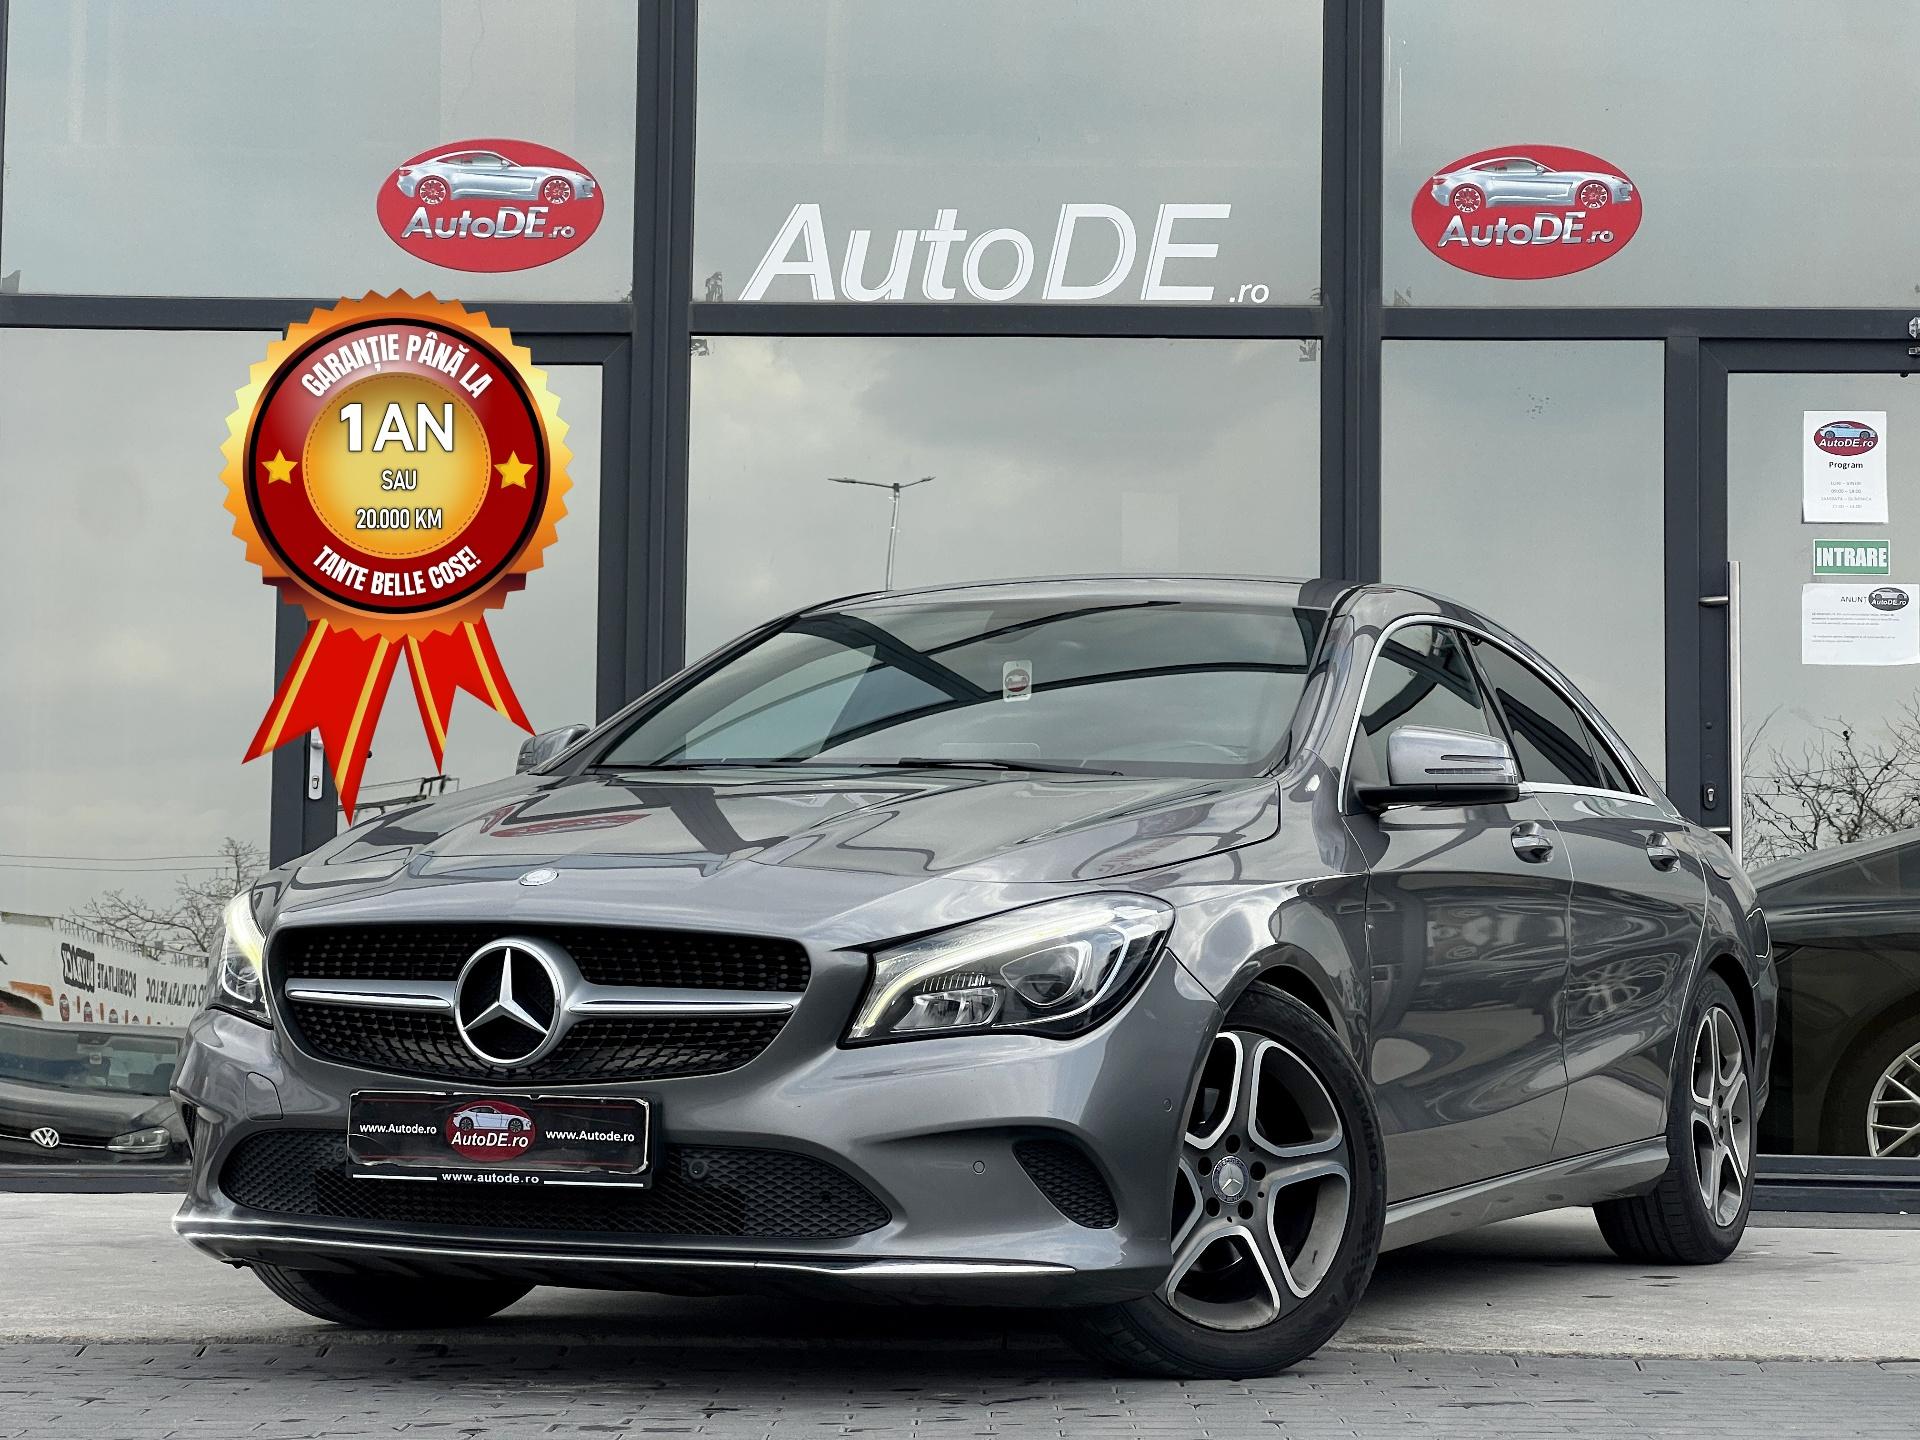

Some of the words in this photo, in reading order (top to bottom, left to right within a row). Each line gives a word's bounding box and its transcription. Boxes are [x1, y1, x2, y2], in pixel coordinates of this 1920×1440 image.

[1819, 438, 1874, 447] AutoDE.ro
[1828, 461, 1864, 470] Program
[1816, 547, 1888, 567] INTRARE
[359, 1123, 437, 1135] www.Autode.ro
[451, 1131, 529, 1149] AutoDE.ro
[545, 1129, 635, 1142] www.Autode.ro
[442, 1172, 539, 1184] www.autode.ro
